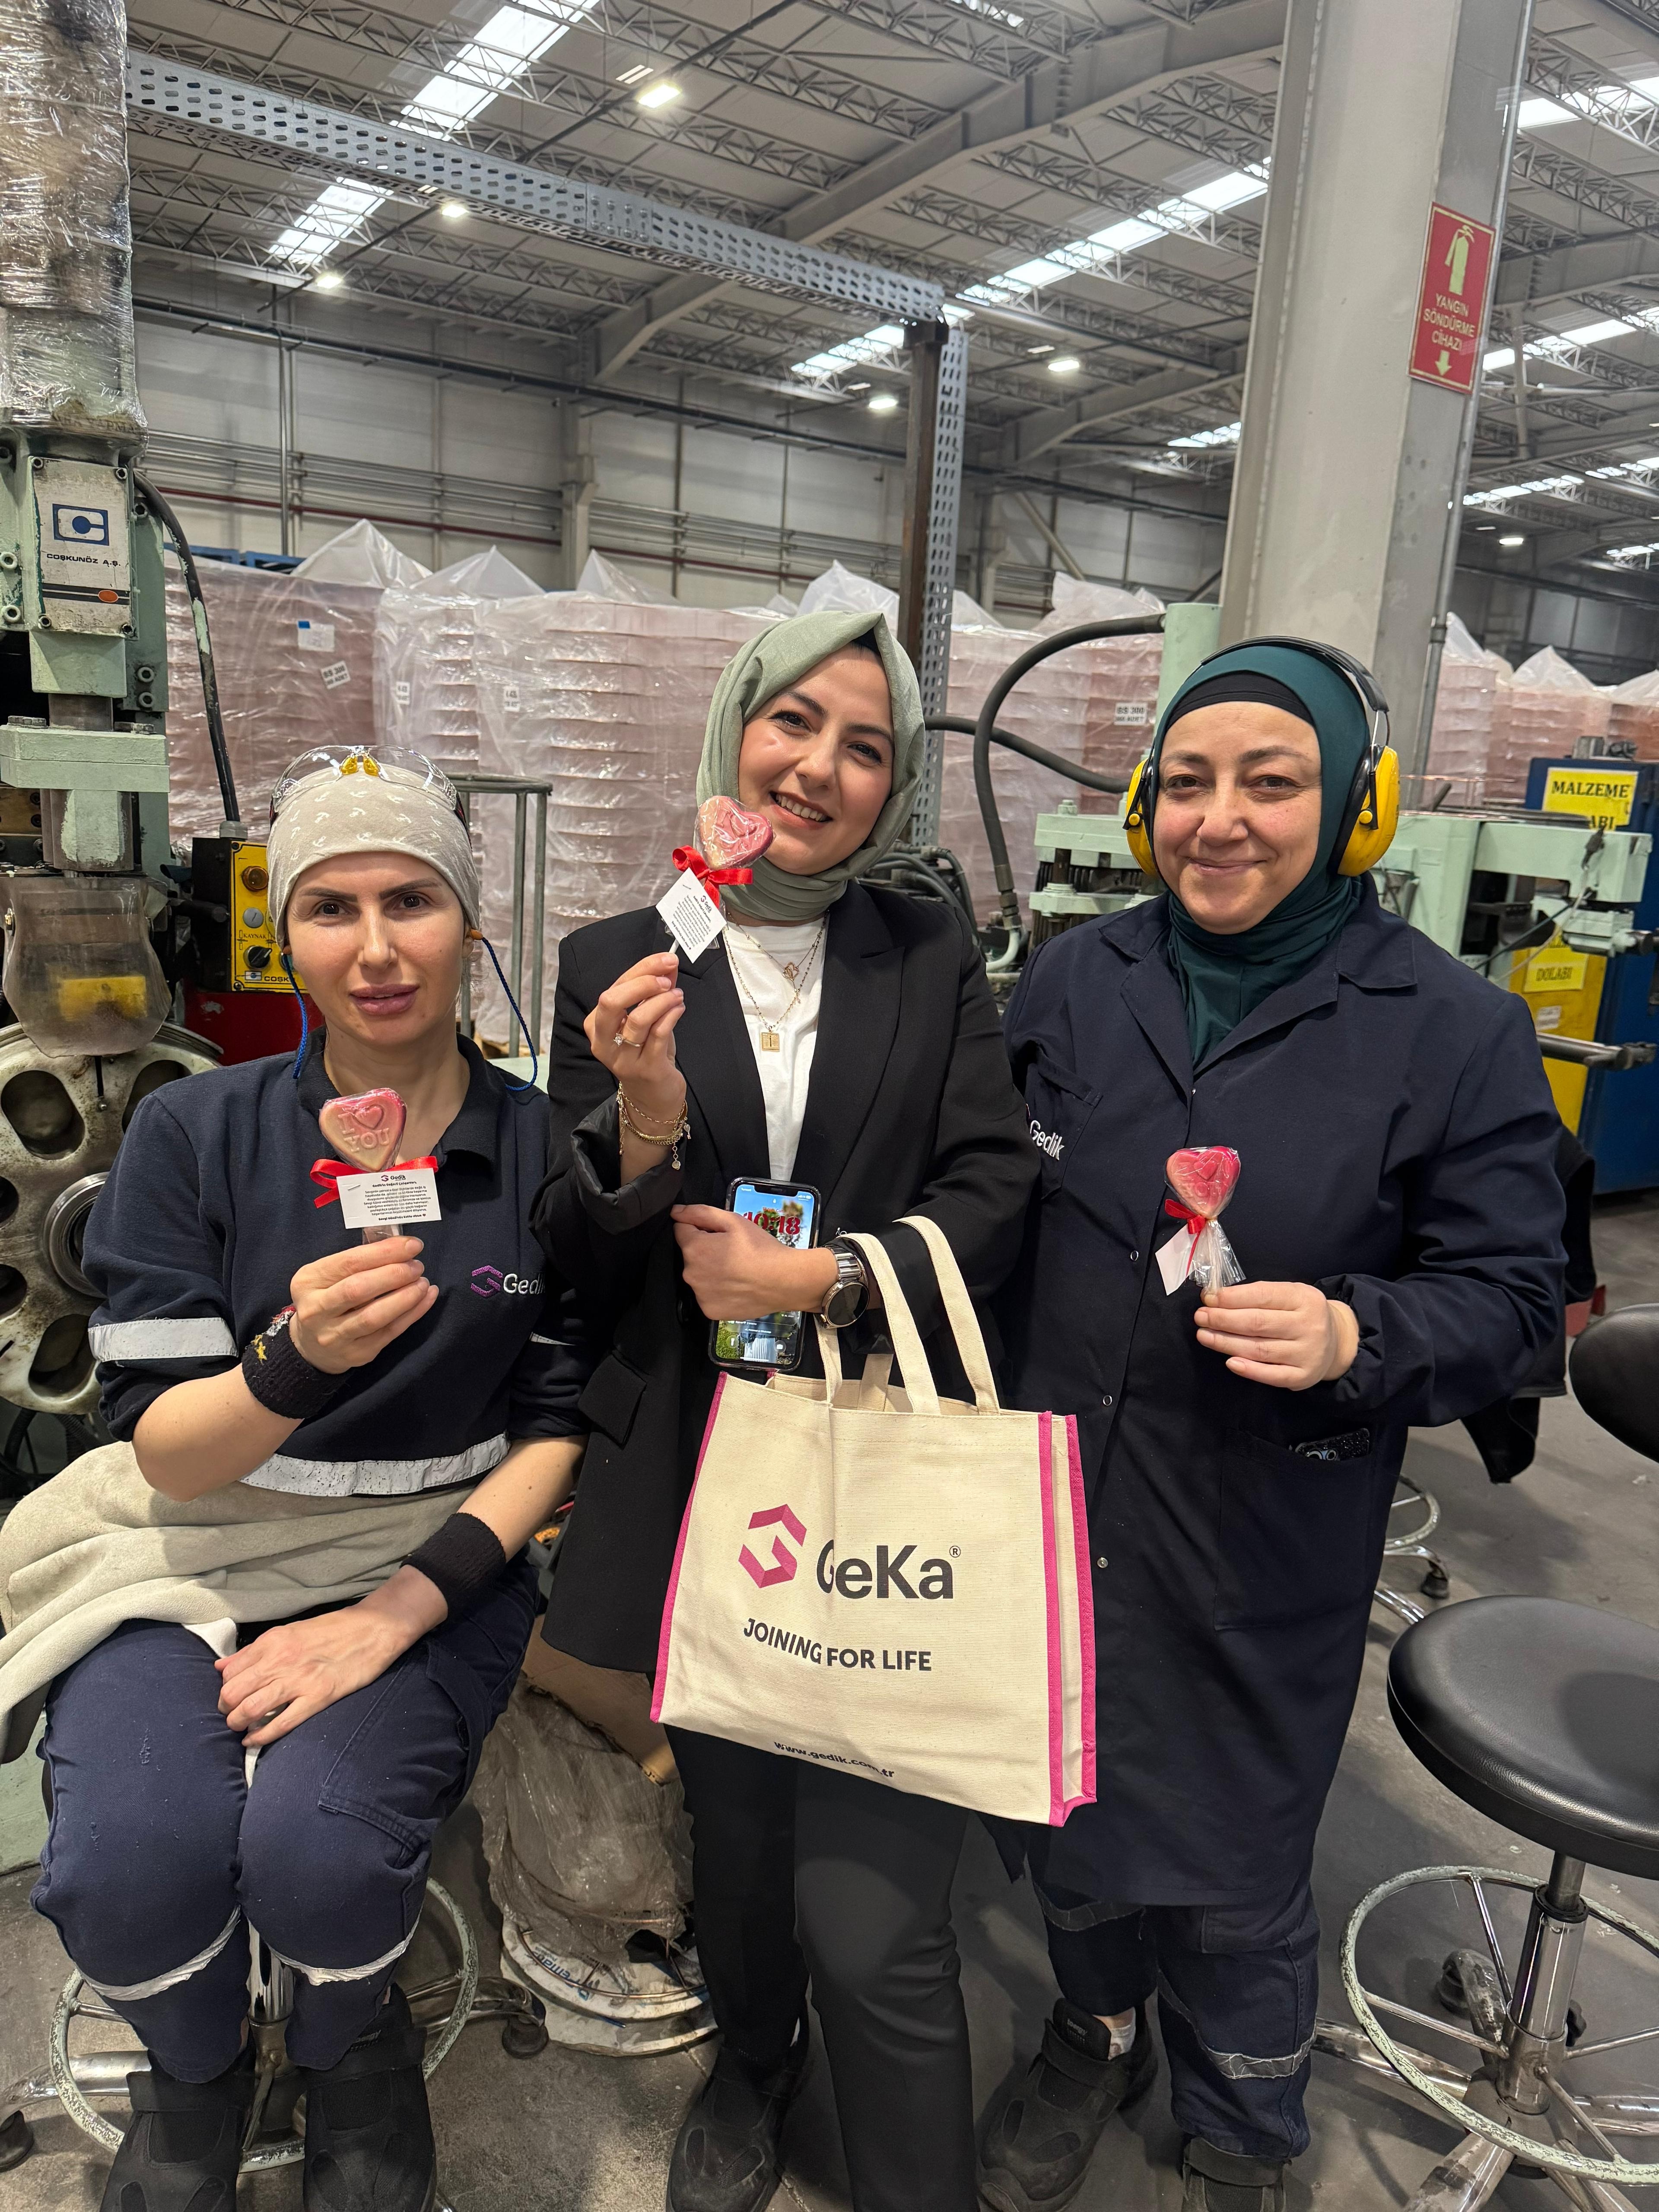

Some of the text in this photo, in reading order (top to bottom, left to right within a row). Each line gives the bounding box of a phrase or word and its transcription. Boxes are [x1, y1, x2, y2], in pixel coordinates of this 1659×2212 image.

[1436, 292, 1469, 317] YANGIN
[1423, 308, 1475, 337] SÖNDÜRME
[1431, 329, 1462, 351] CİHAZI
[47, 553, 98, 563] COŞKUNÖZ
[1551, 781, 1631, 798] MALZEME
[343, 1127, 390, 1153] YOU
[1030, 1119, 1065, 1160] Gedik
[744, 1618, 931, 1671] JOINING FOR LIFE
[774, 1742, 894, 1777] www.gedik.com.tr
